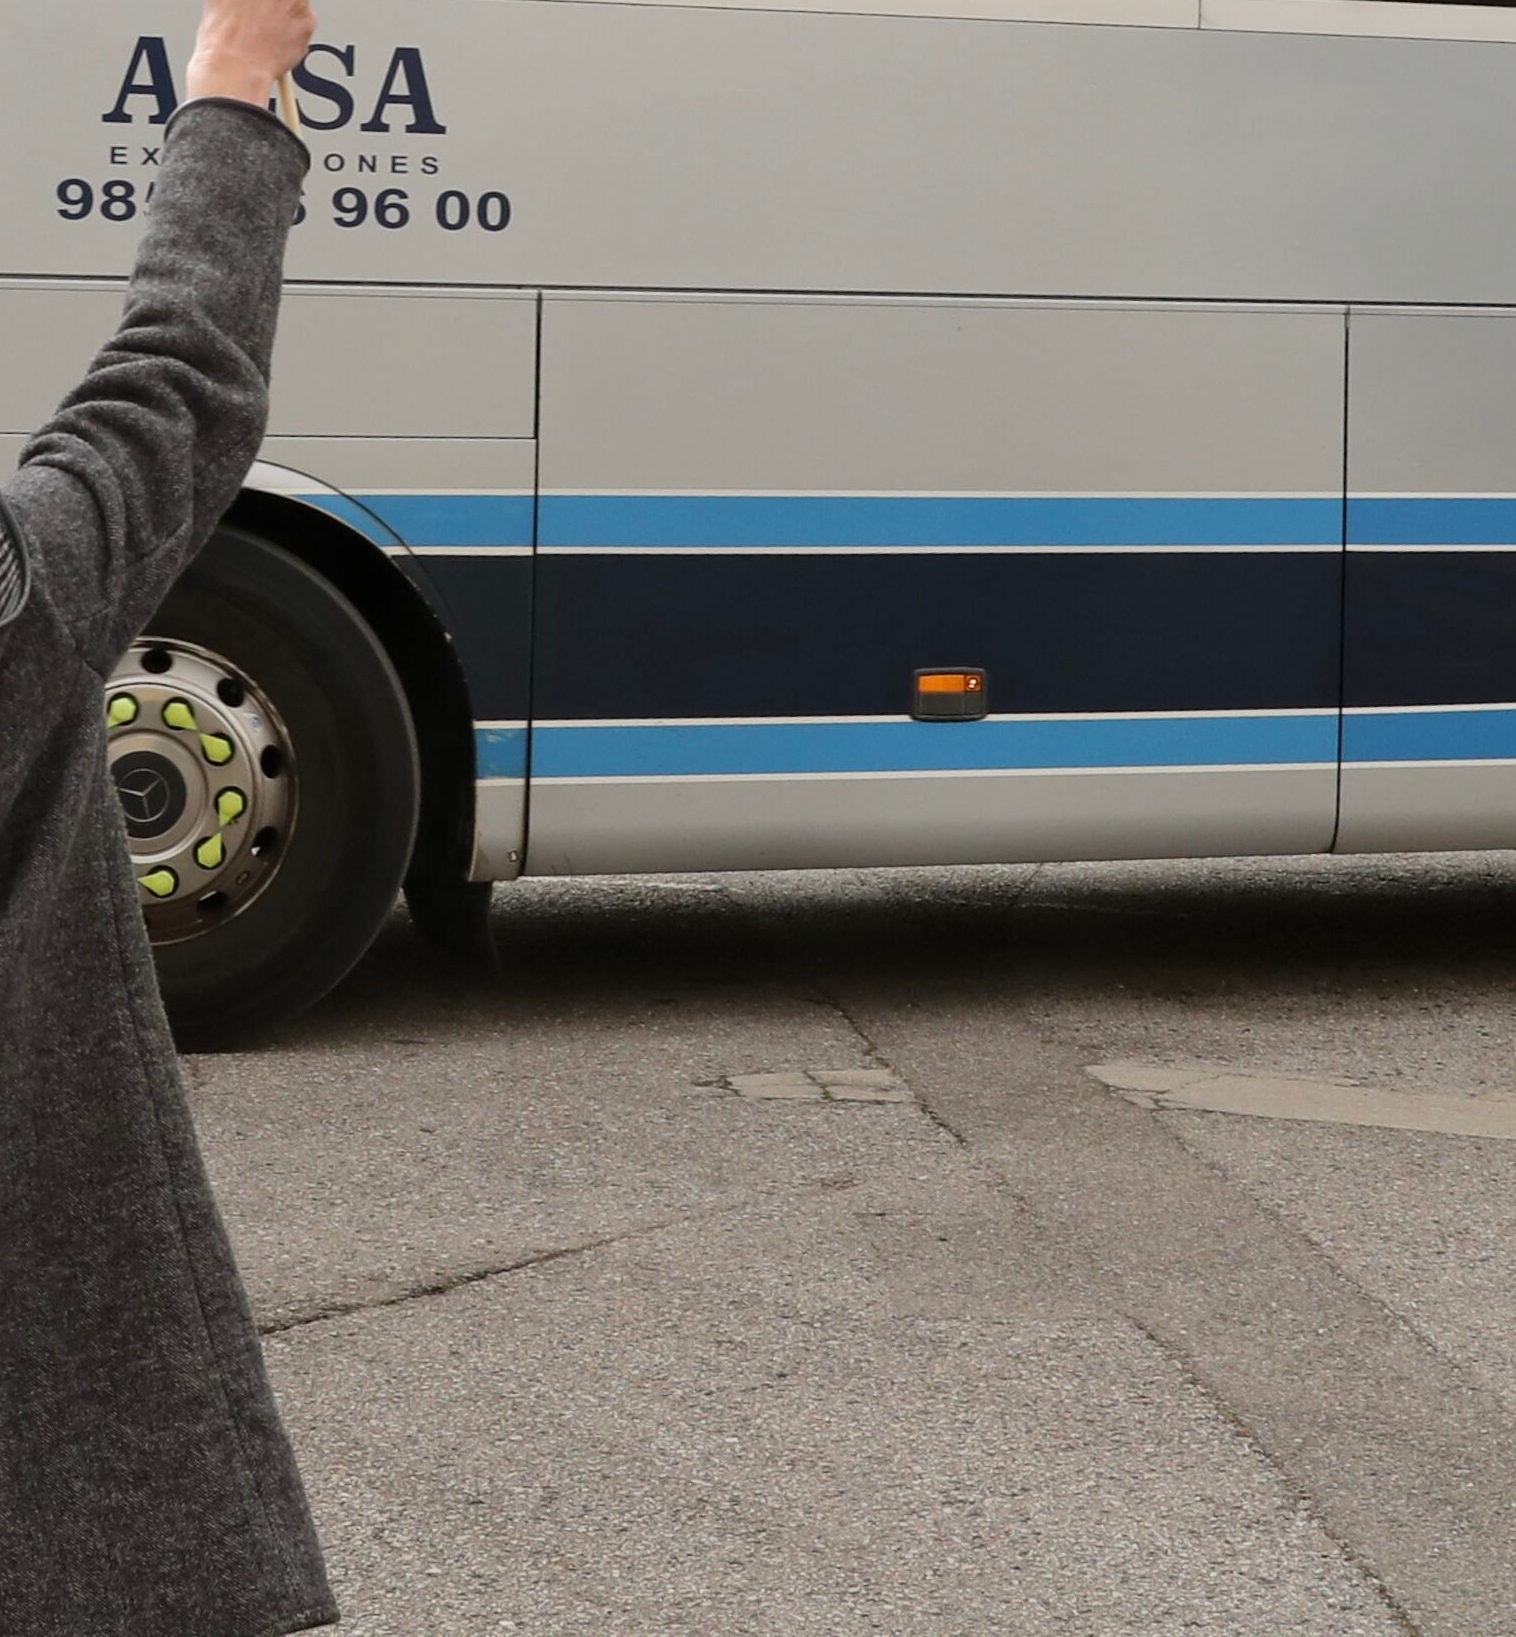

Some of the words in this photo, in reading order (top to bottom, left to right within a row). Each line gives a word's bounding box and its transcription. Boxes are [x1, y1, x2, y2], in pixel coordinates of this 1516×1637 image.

[101, 36, 447, 135] ASA
[109, 145, 440, 175] EXONES
[332, 186, 411, 230] 96
[435, 190, 512, 232] 00
